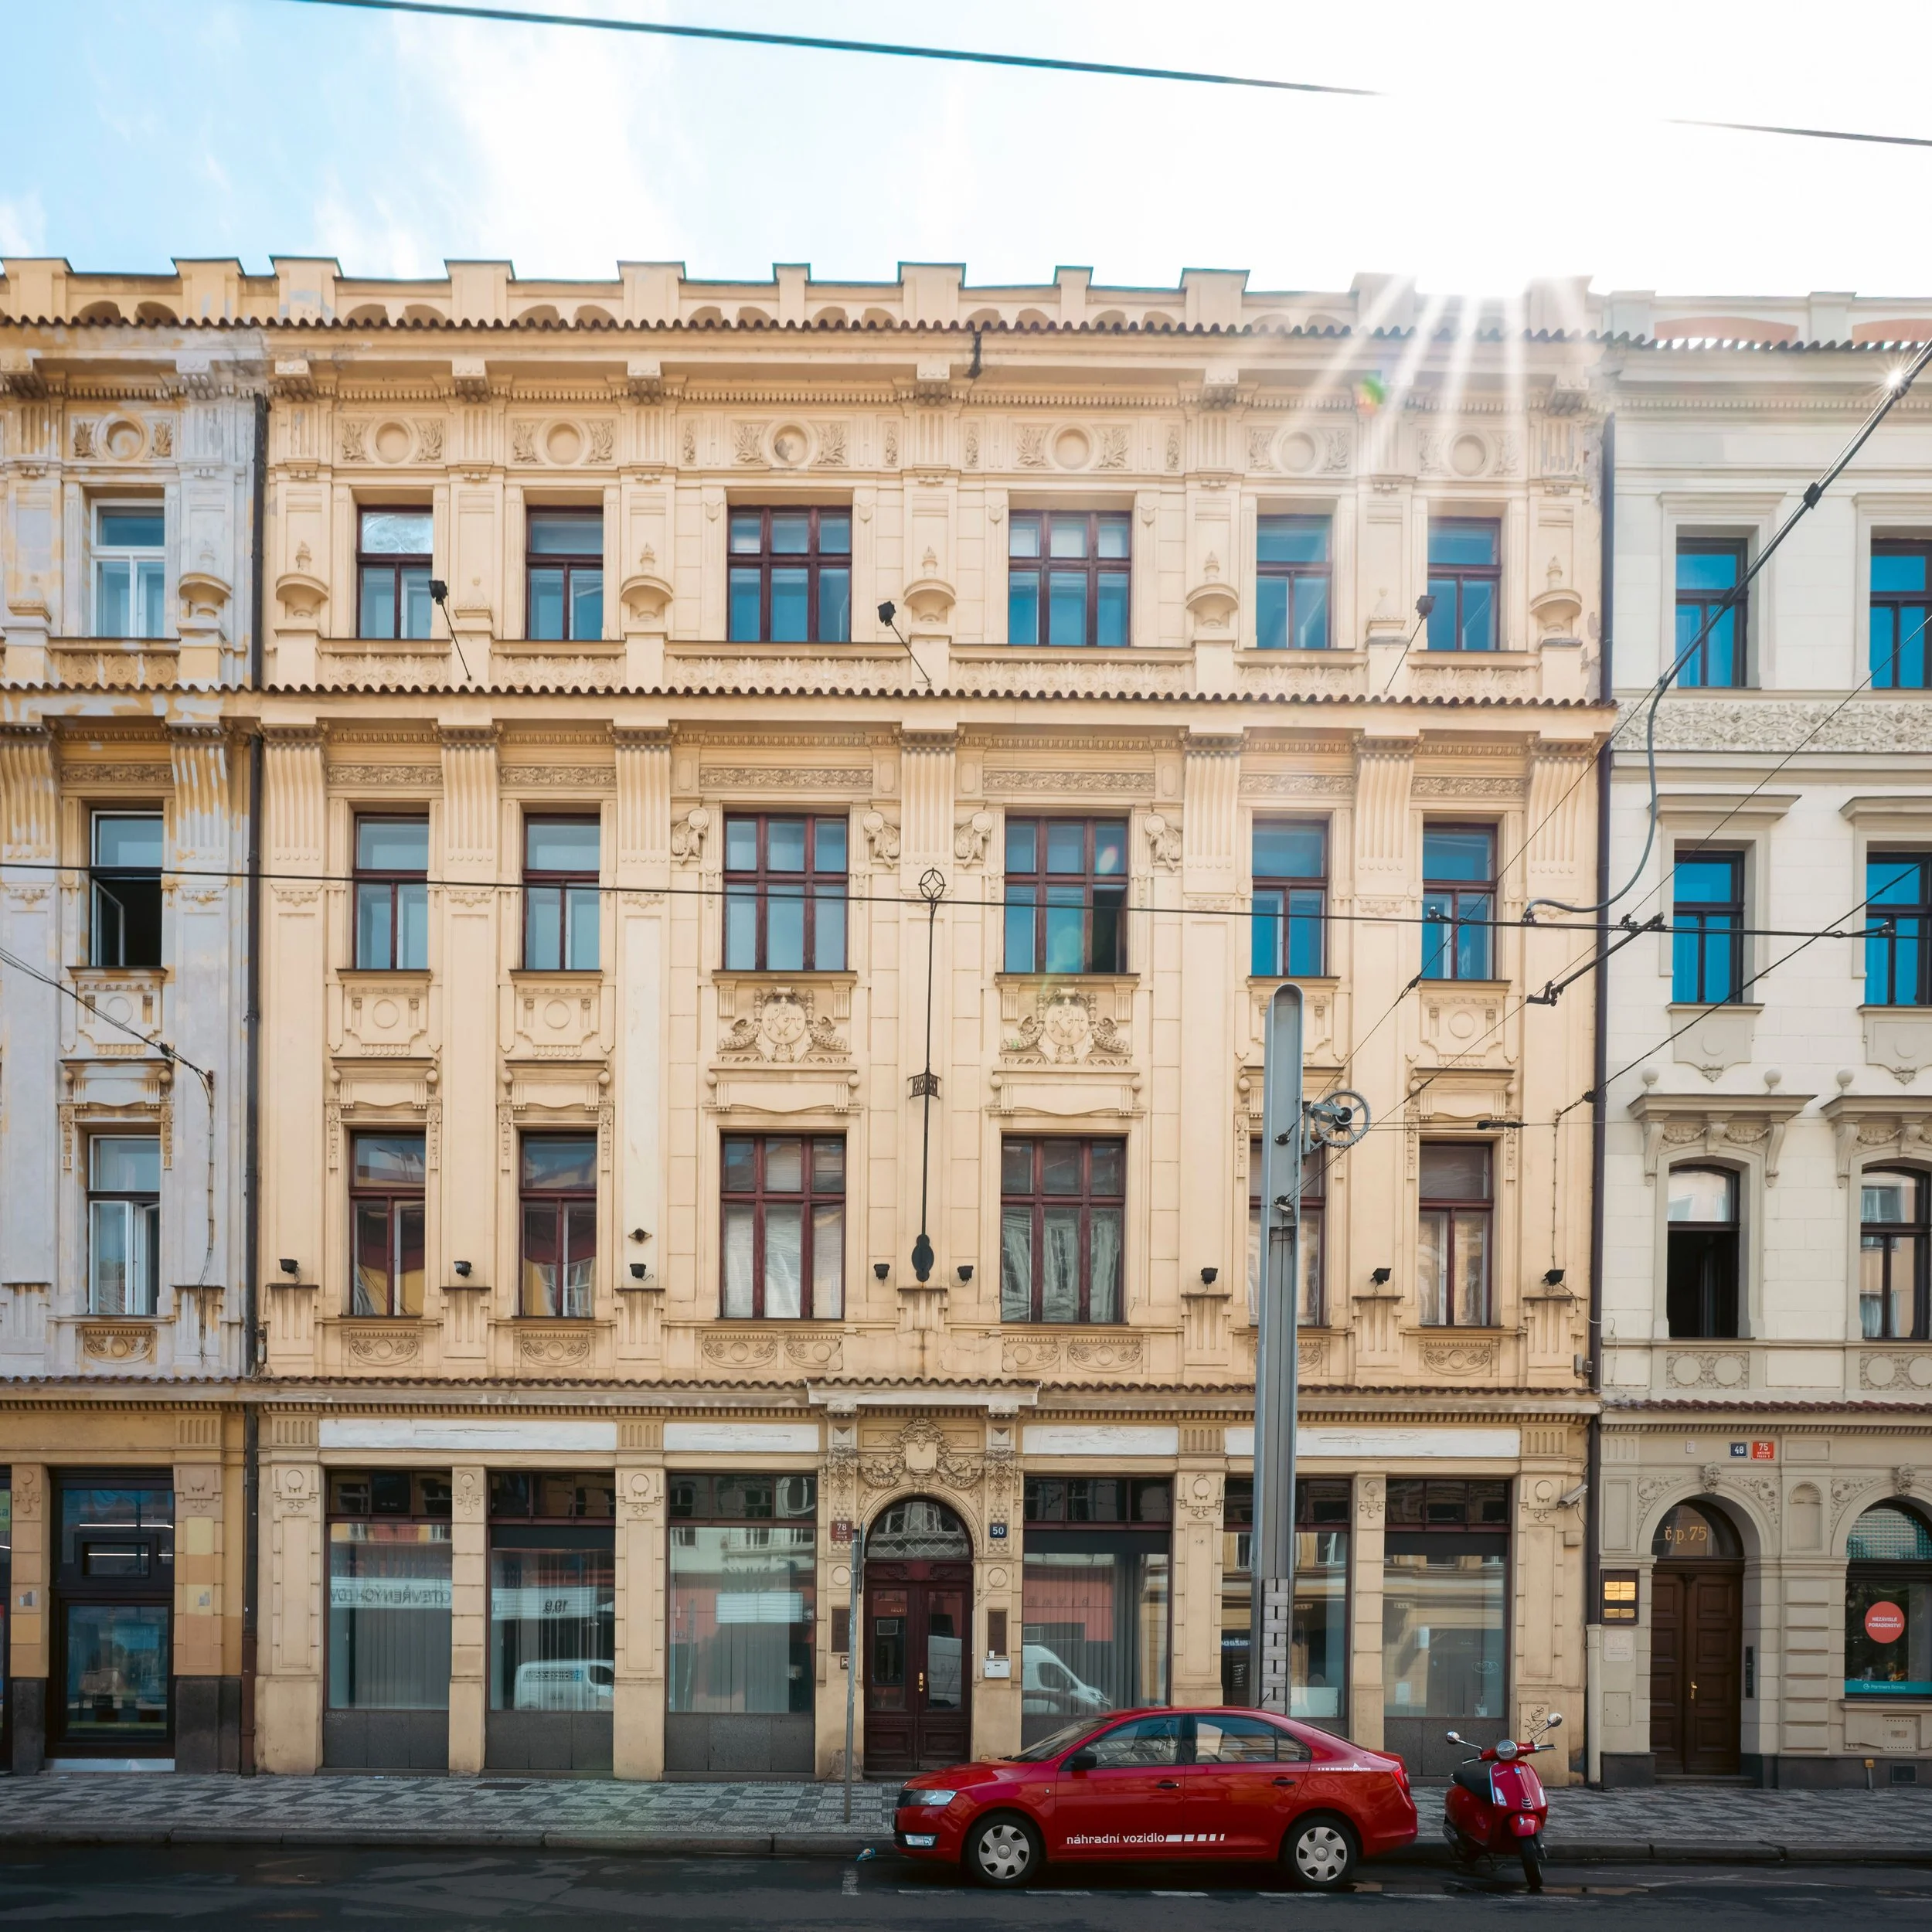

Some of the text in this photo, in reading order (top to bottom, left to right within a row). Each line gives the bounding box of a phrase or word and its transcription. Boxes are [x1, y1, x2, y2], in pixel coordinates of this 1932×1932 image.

[1734, 1446, 1744, 1454] 48
[1758, 1443, 1769, 1451] 75
[992, 1526, 1005, 1535] 50
[1689, 1526, 1707, 1541] 75
[1066, 1833, 1165, 1845] náhradní vozidlo
